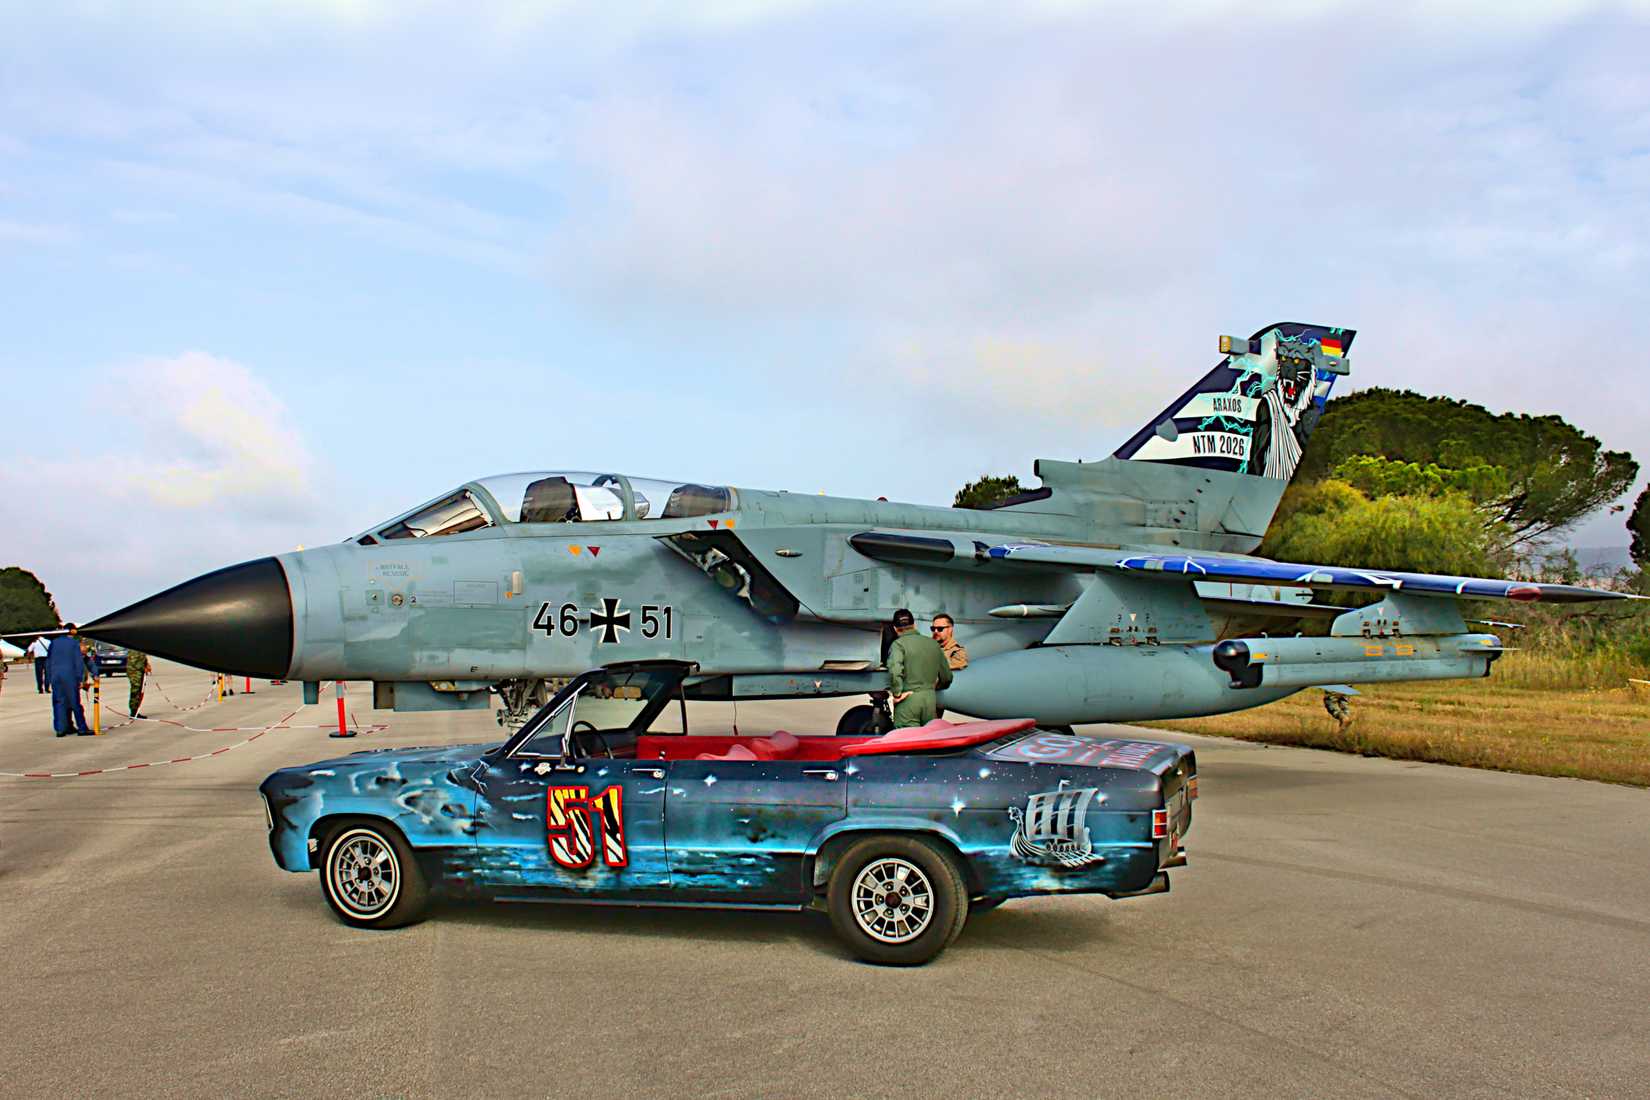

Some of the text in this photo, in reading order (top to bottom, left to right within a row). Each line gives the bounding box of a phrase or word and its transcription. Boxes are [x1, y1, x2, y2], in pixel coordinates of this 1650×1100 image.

[1213, 397, 1242, 413] ARAXOS
[1193, 434, 1245, 456] NTM 2026
[532, 601, 672, 639] 46 51
[547, 785, 628, 868] 51
